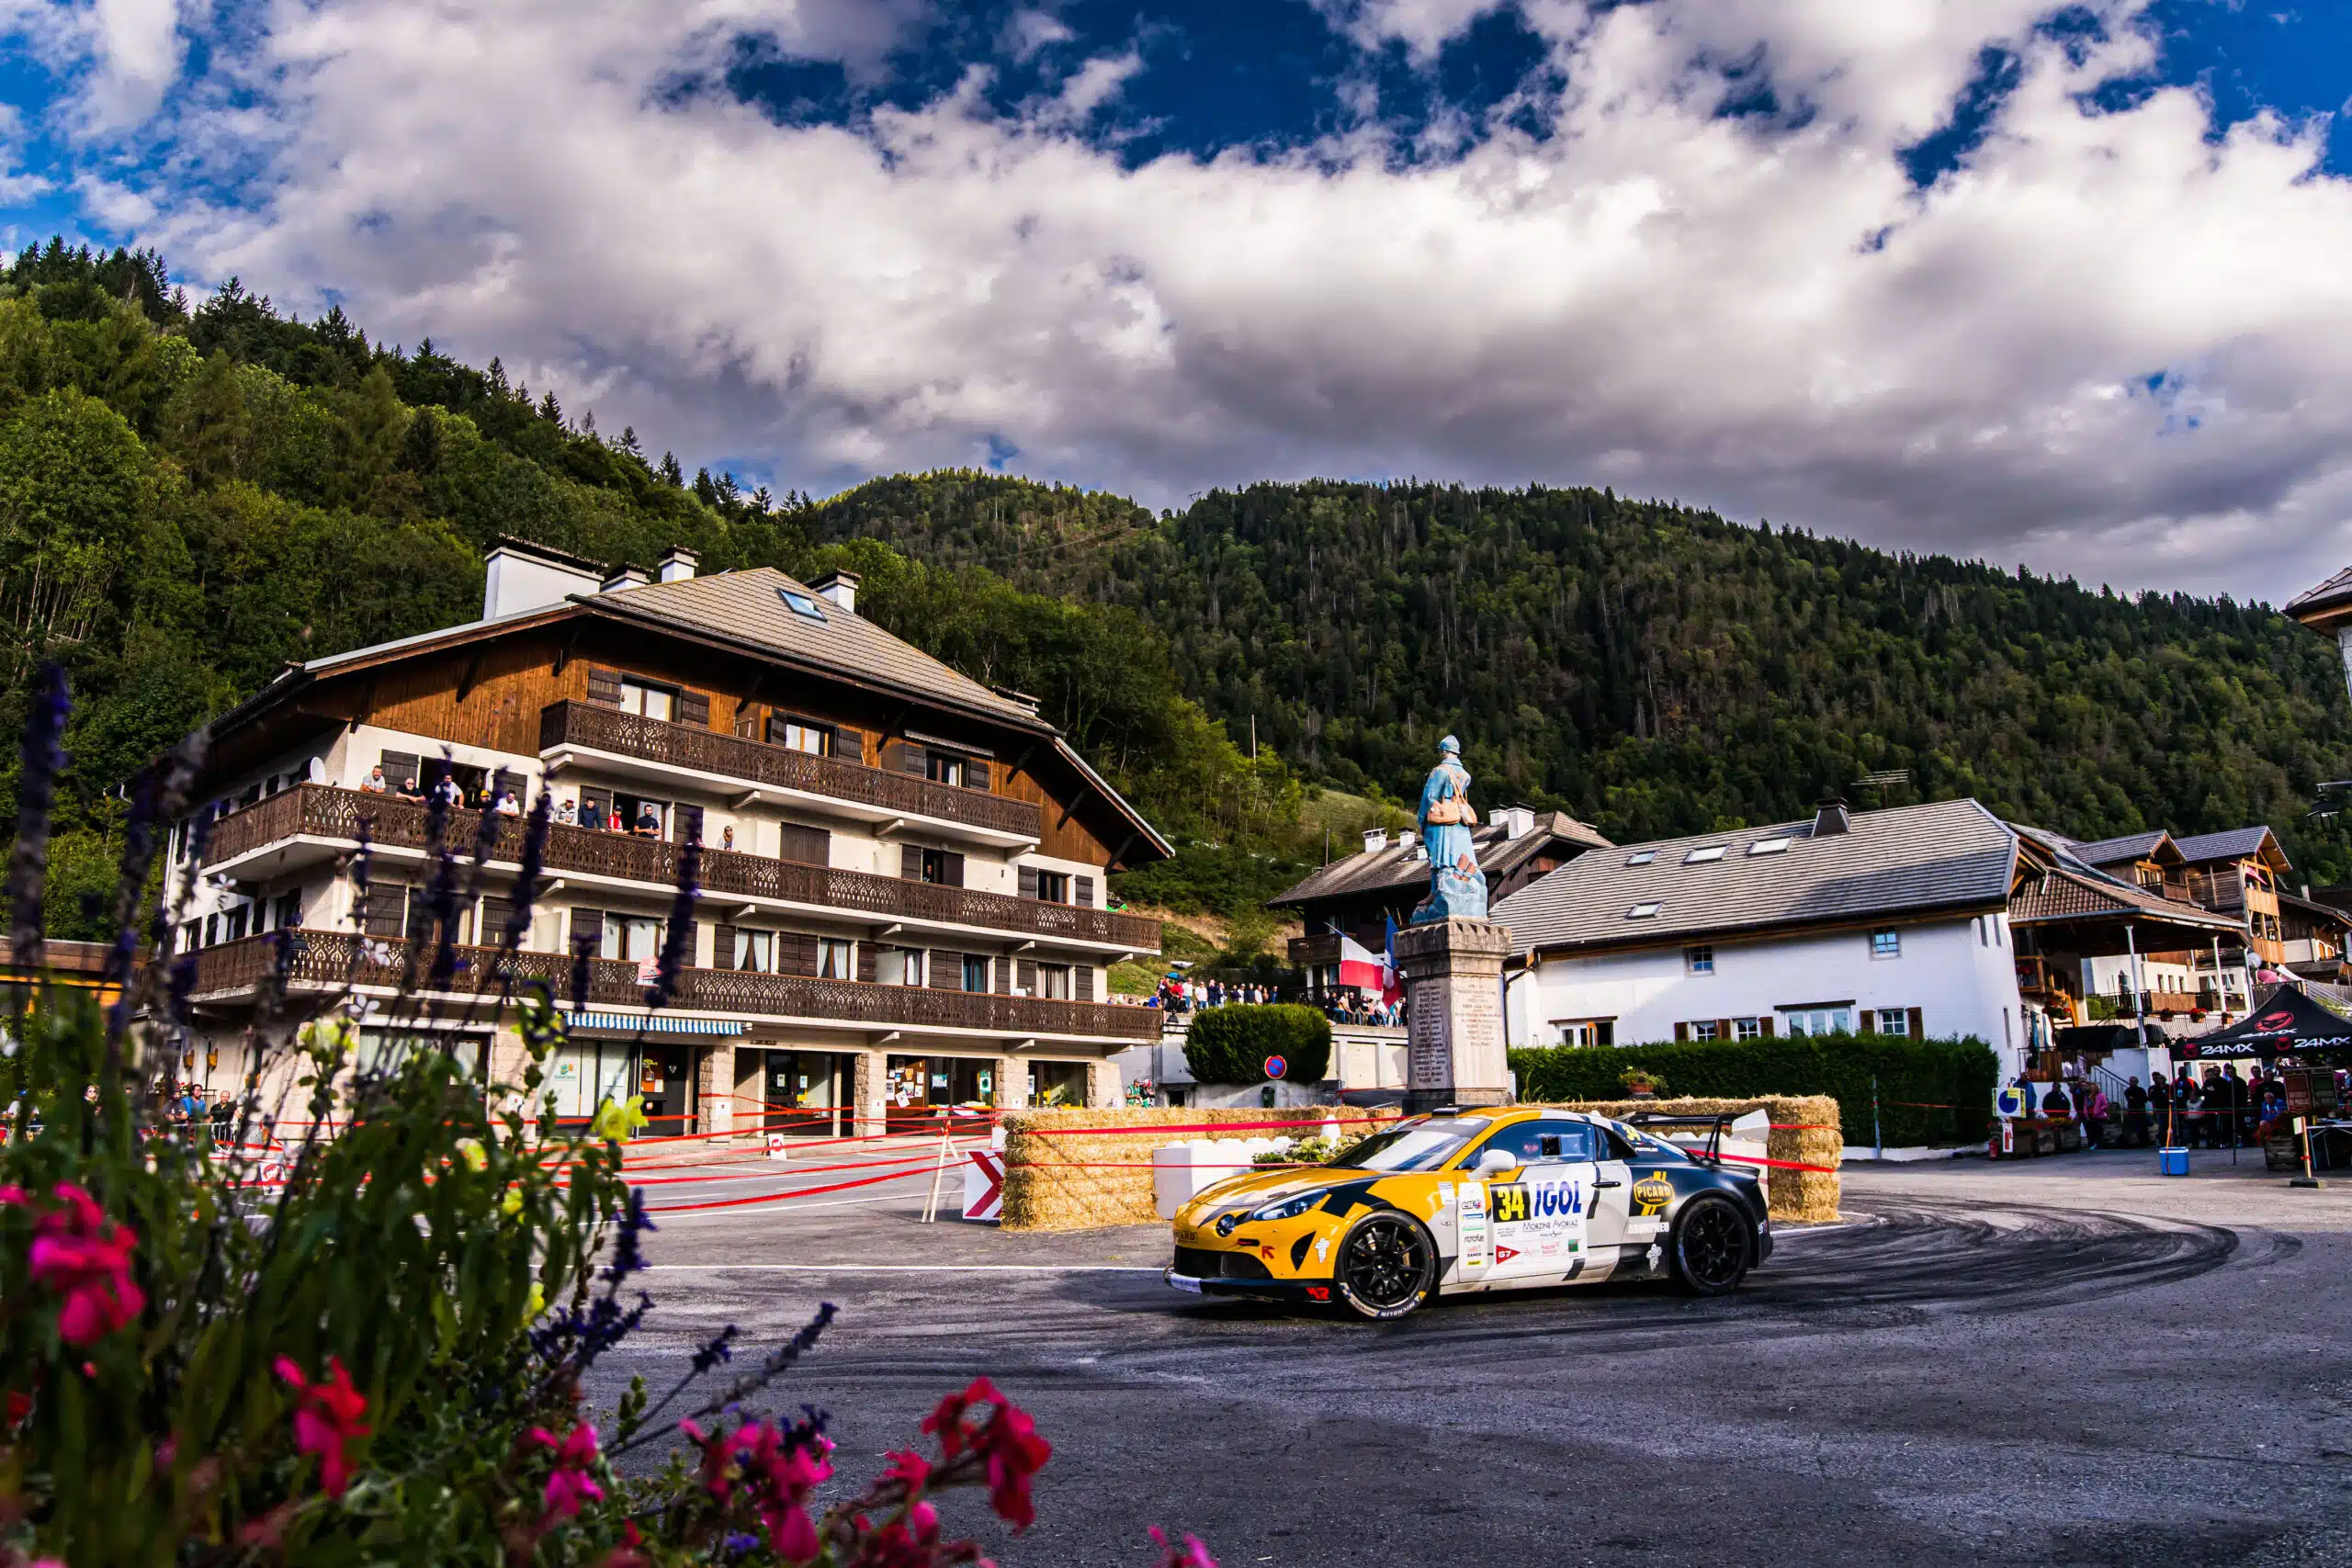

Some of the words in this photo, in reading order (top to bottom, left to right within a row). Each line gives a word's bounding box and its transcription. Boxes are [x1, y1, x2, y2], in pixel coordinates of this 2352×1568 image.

[2293, 1036, 2352, 1048] 24MX
[2201, 1043, 2256, 1055] 24MX
[1636, 1185, 1671, 1198] PICARD
[1497, 1185, 1525, 1221] 34
[1534, 1180, 1581, 1217] IGOL
